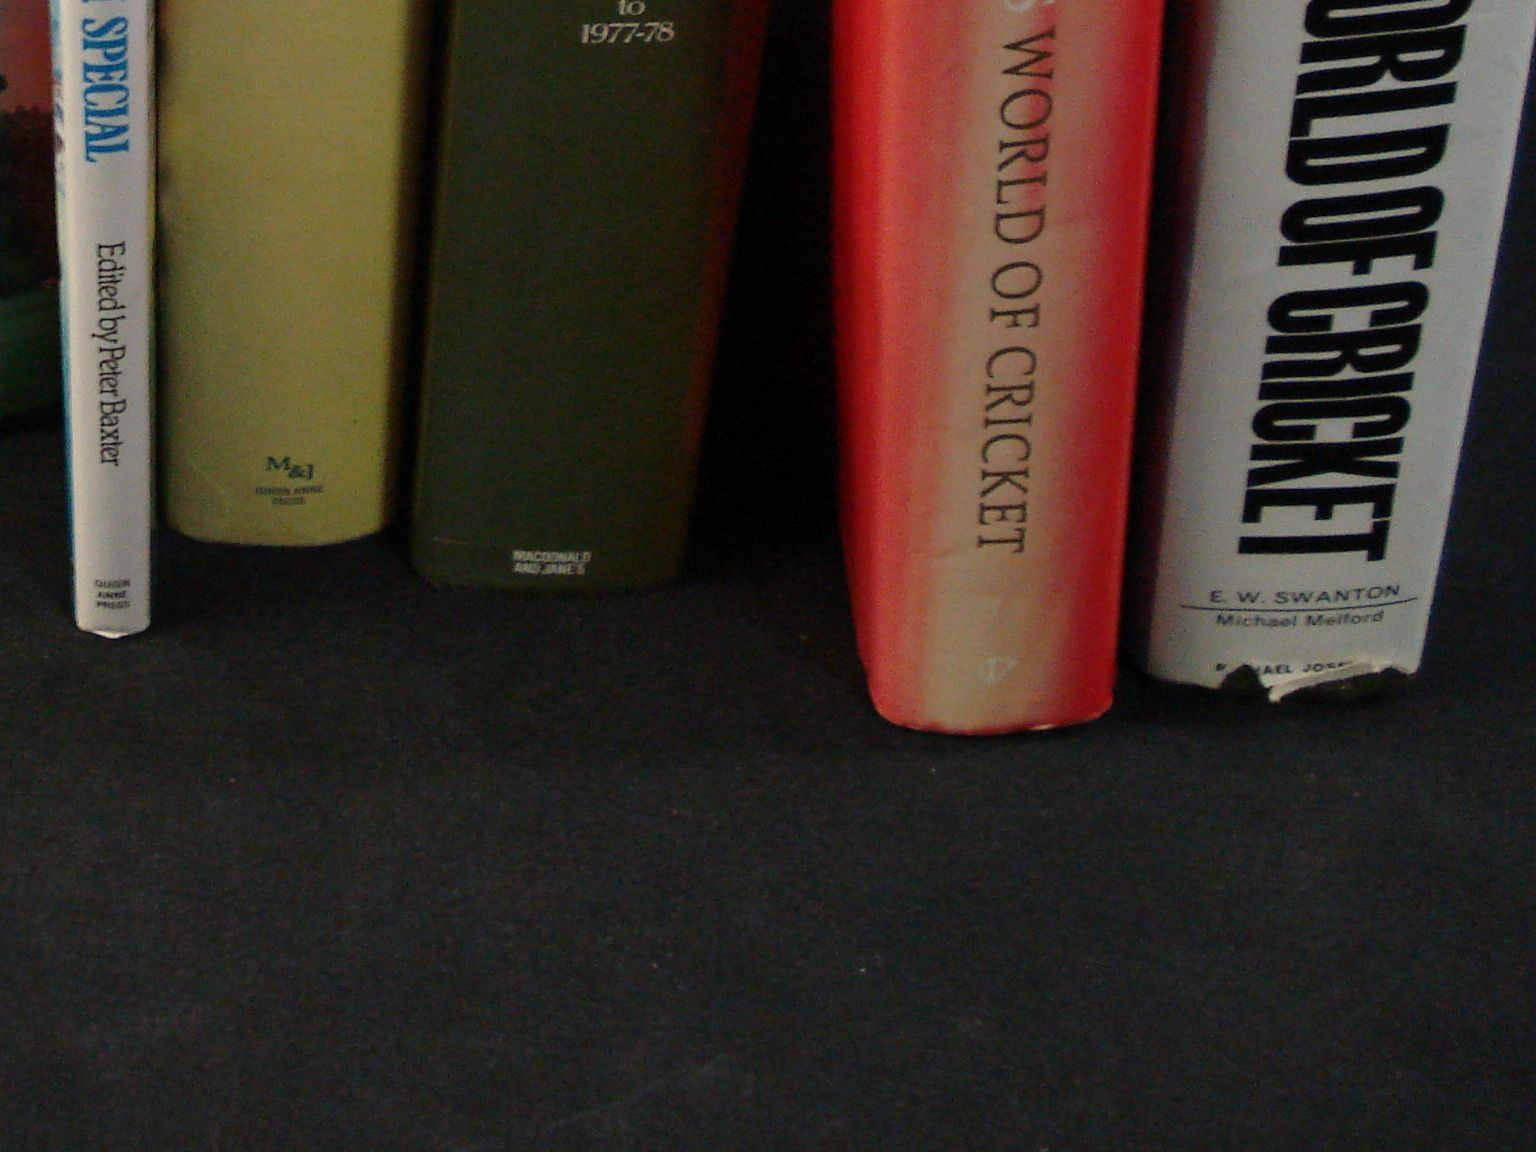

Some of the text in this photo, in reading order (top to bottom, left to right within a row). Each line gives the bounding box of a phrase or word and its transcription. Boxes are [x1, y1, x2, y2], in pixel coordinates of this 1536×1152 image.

[82, 16, 131, 163] SPECIAL
[580, 22, 675, 45] 1977-78
[994, 31, 1055, 245] WORLD
[1277, 185, 1446, 276] OF
[93, 240, 127, 467] Edited by Peter Baxter
[989, 260, 1043, 332] OF
[977, 347, 1037, 554] CRICKET
[1237, 280, 1430, 562] CRICKET
[1216, 610, 1385, 628] Michael Melford
[1274, 584, 1402, 605] SWANTON
